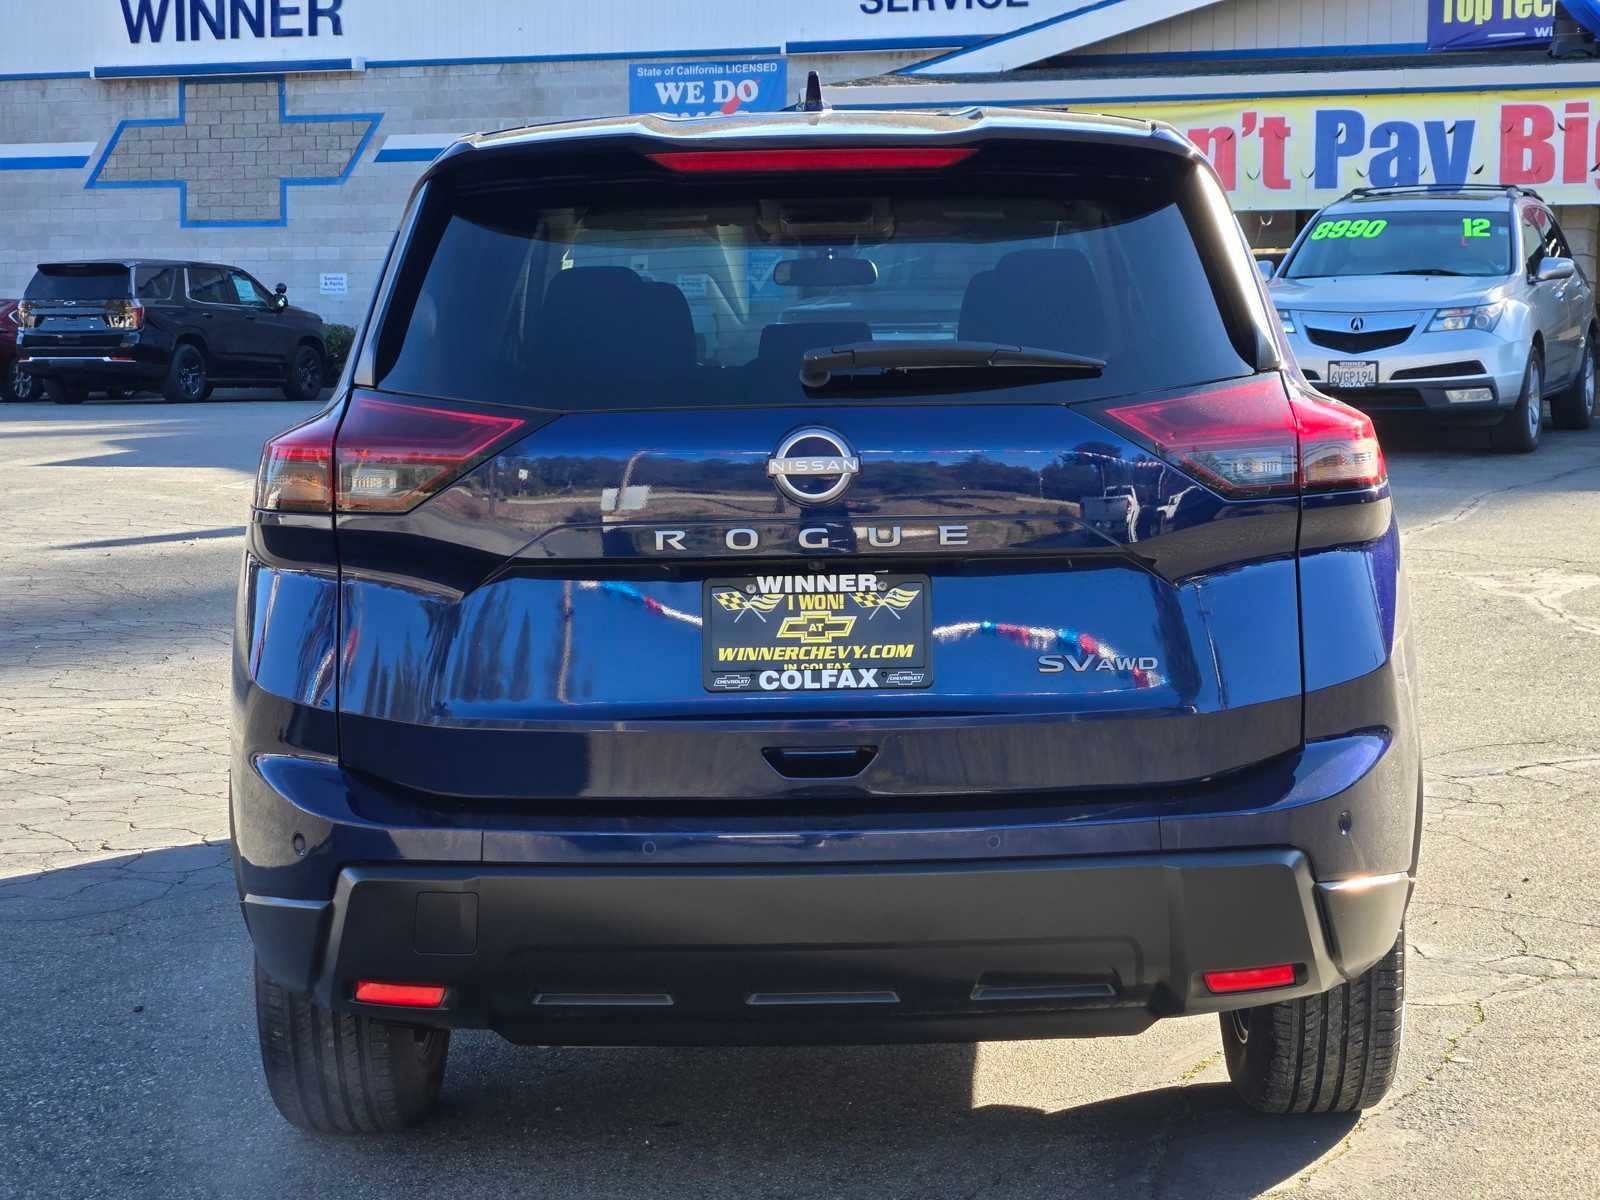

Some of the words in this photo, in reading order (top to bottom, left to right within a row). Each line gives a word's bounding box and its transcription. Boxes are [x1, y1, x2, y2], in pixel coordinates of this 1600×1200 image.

[1503, 0, 1555, 19] Tec
[120, 0, 343, 43] WINNER
[637, 66, 662, 77] State
[664, 65, 674, 75] of
[677, 64, 723, 75] California
[725, 62, 777, 73] LICENSED
[655, 81, 705, 105] WE
[713, 79, 759, 103] DO
[1314, 108, 1475, 194] Pay
[1500, 102, 1600, 186] Bi
[1311, 218, 1388, 241] 8990
[1462, 217, 1491, 237] 12
[771, 459, 858, 472] NISSAN
[654, 525, 968, 550] ROGUE
[756, 574, 877, 593] WINNER
[799, 593, 845, 610] WON!
[808, 622, 825, 632] AT
[718, 644, 914, 661] WINNERCHEVY.COM
[1037, 653, 1097, 673] SV
[1095, 656, 1159, 671] AWD
[758, 668, 879, 690] COLFAX
